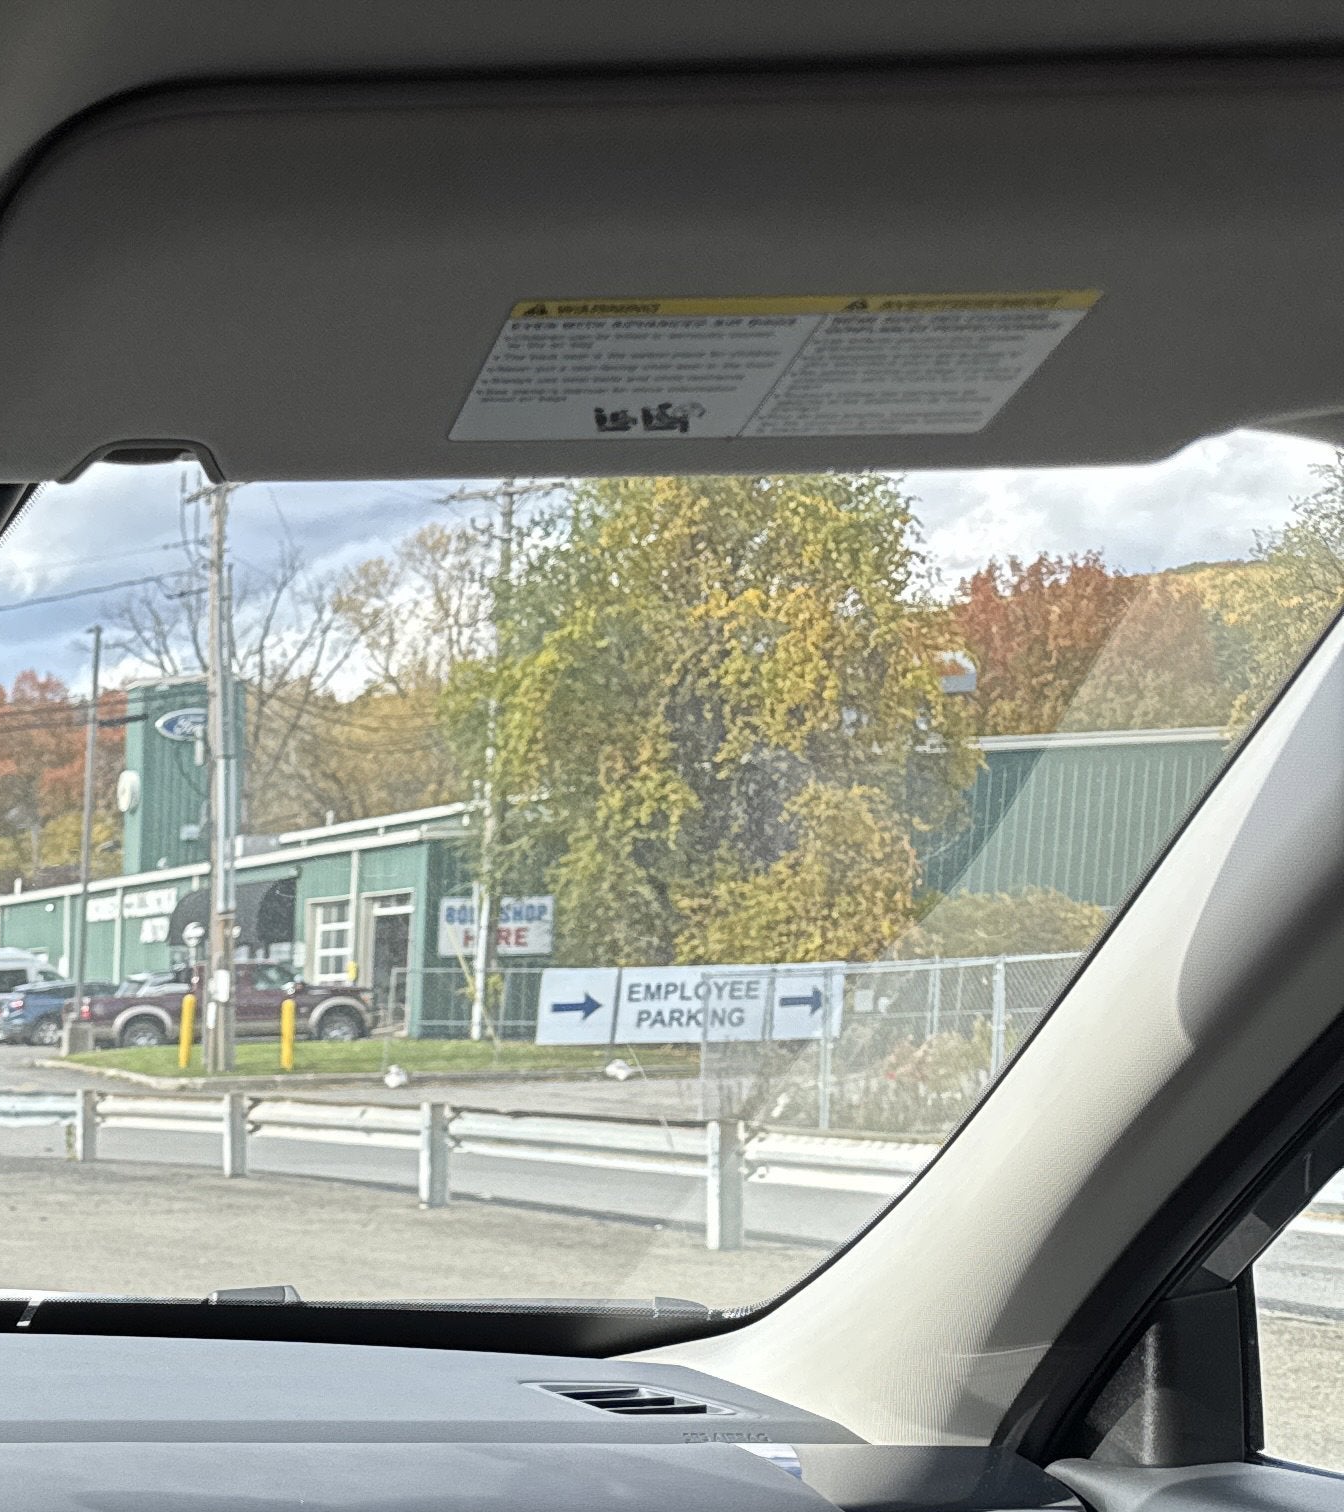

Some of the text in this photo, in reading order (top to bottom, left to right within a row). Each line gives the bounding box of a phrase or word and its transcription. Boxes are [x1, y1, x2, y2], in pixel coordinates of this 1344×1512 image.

[500, 904, 548, 923] SHOP
[463, 927, 528, 947] HRE
[628, 980, 760, 1003] EMPLOYEE
[636, 1007, 745, 1028] PARKNG
